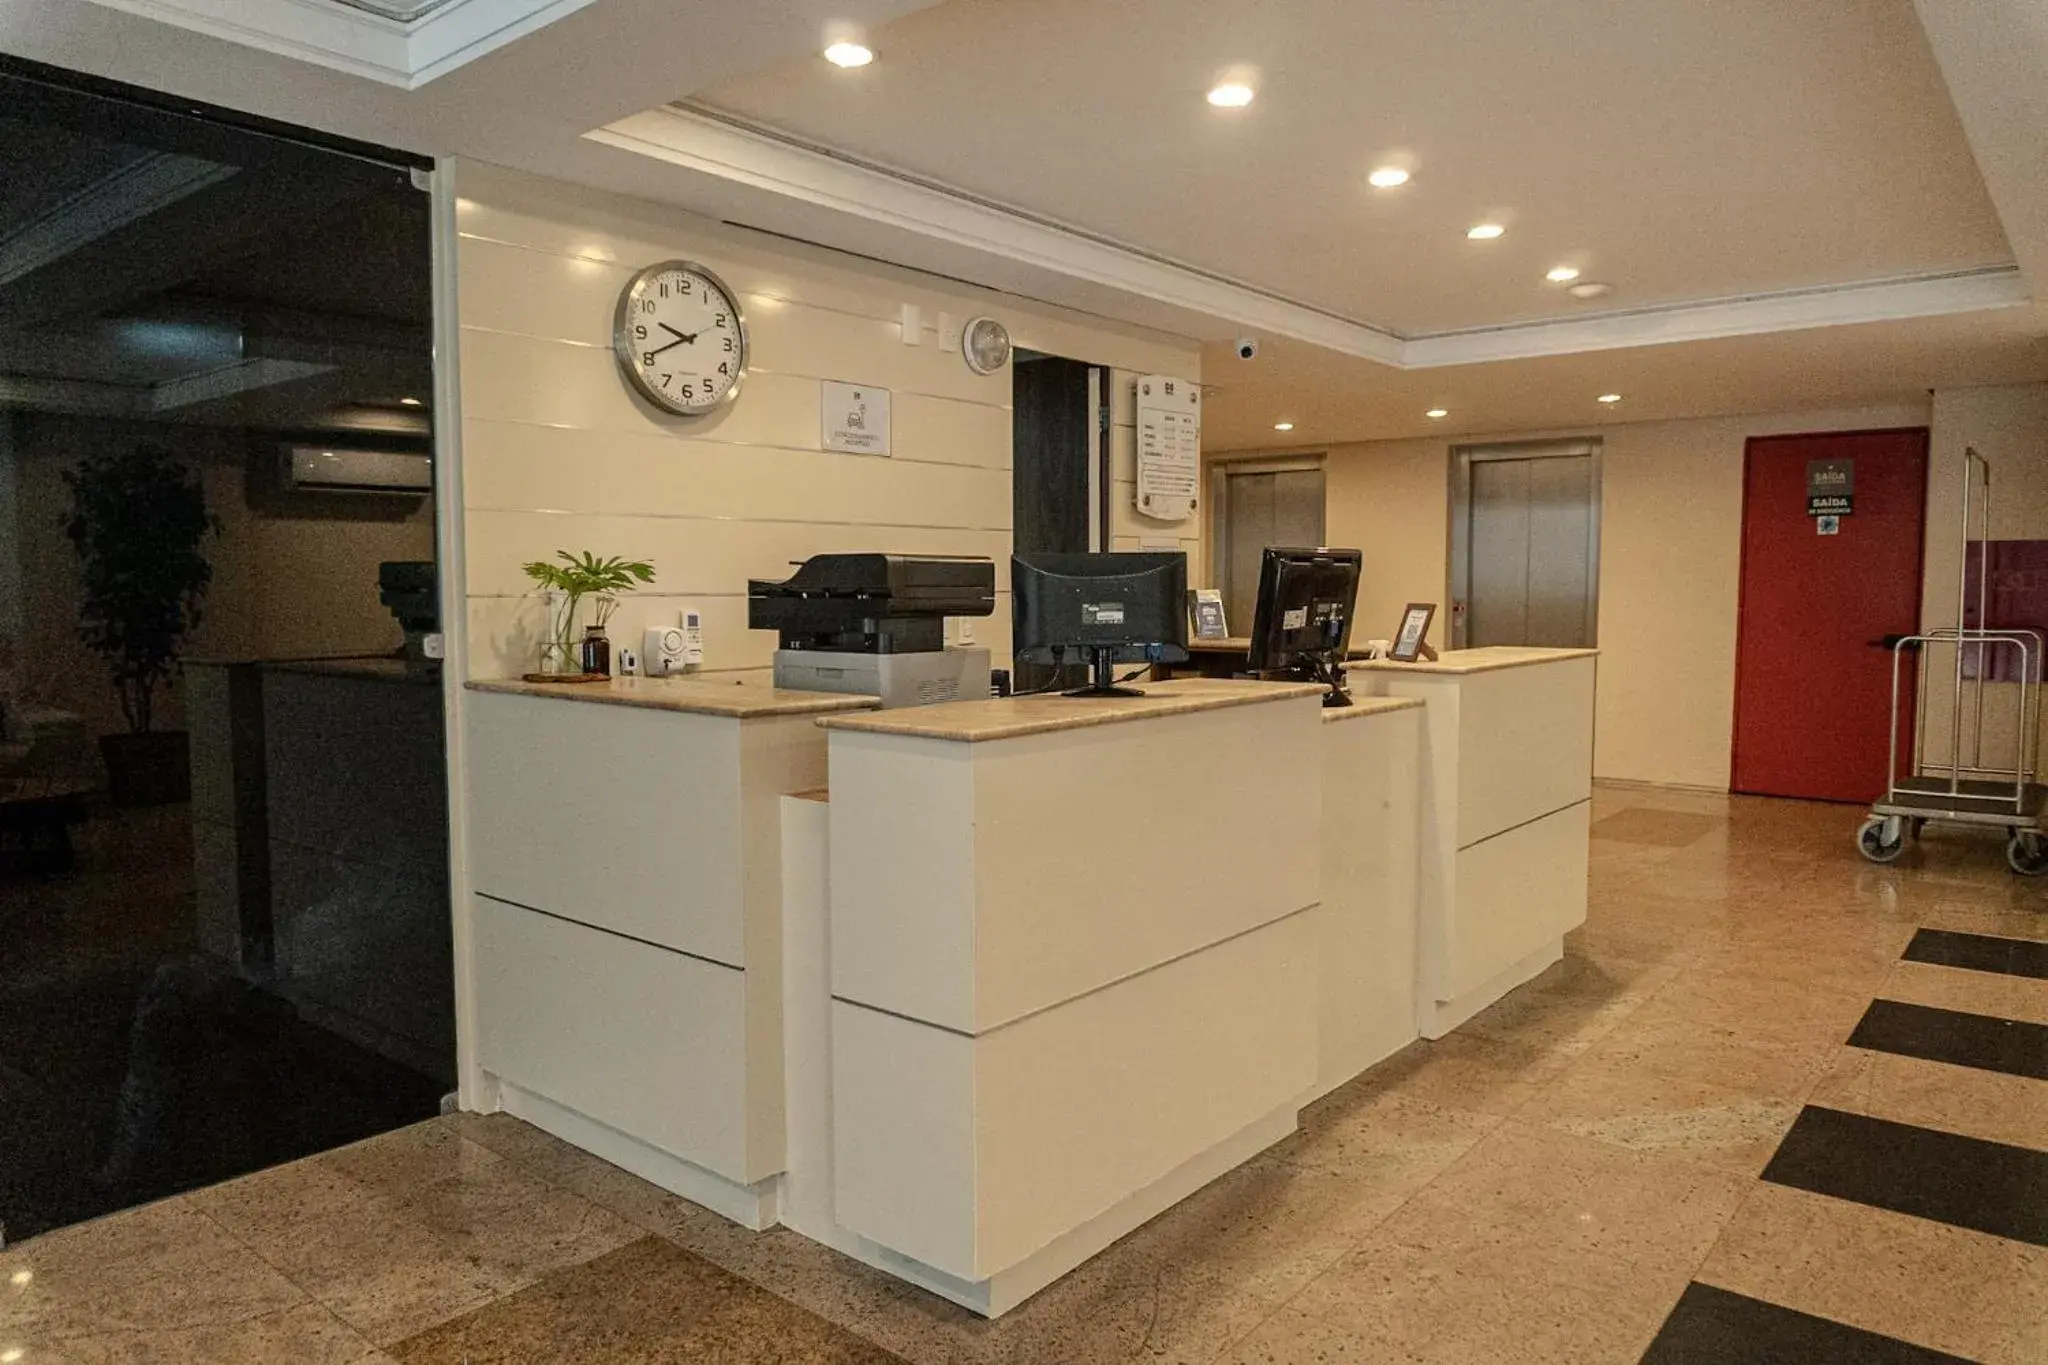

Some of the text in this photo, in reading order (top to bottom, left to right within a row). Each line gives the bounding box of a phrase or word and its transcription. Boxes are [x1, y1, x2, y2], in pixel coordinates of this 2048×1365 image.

[660, 283, 669, 298] 11
[676, 279, 691, 295] 12
[641, 299, 656, 315] 10
[715, 313, 726, 328] 2
[635, 325, 648, 340] 9
[722, 338, 733, 352] 3
[643, 352, 655, 366] 8
[718, 361, 728, 376] 4
[661, 373, 672, 388] 7
[703, 378, 713, 393] 5
[682, 384, 693, 399] 6
